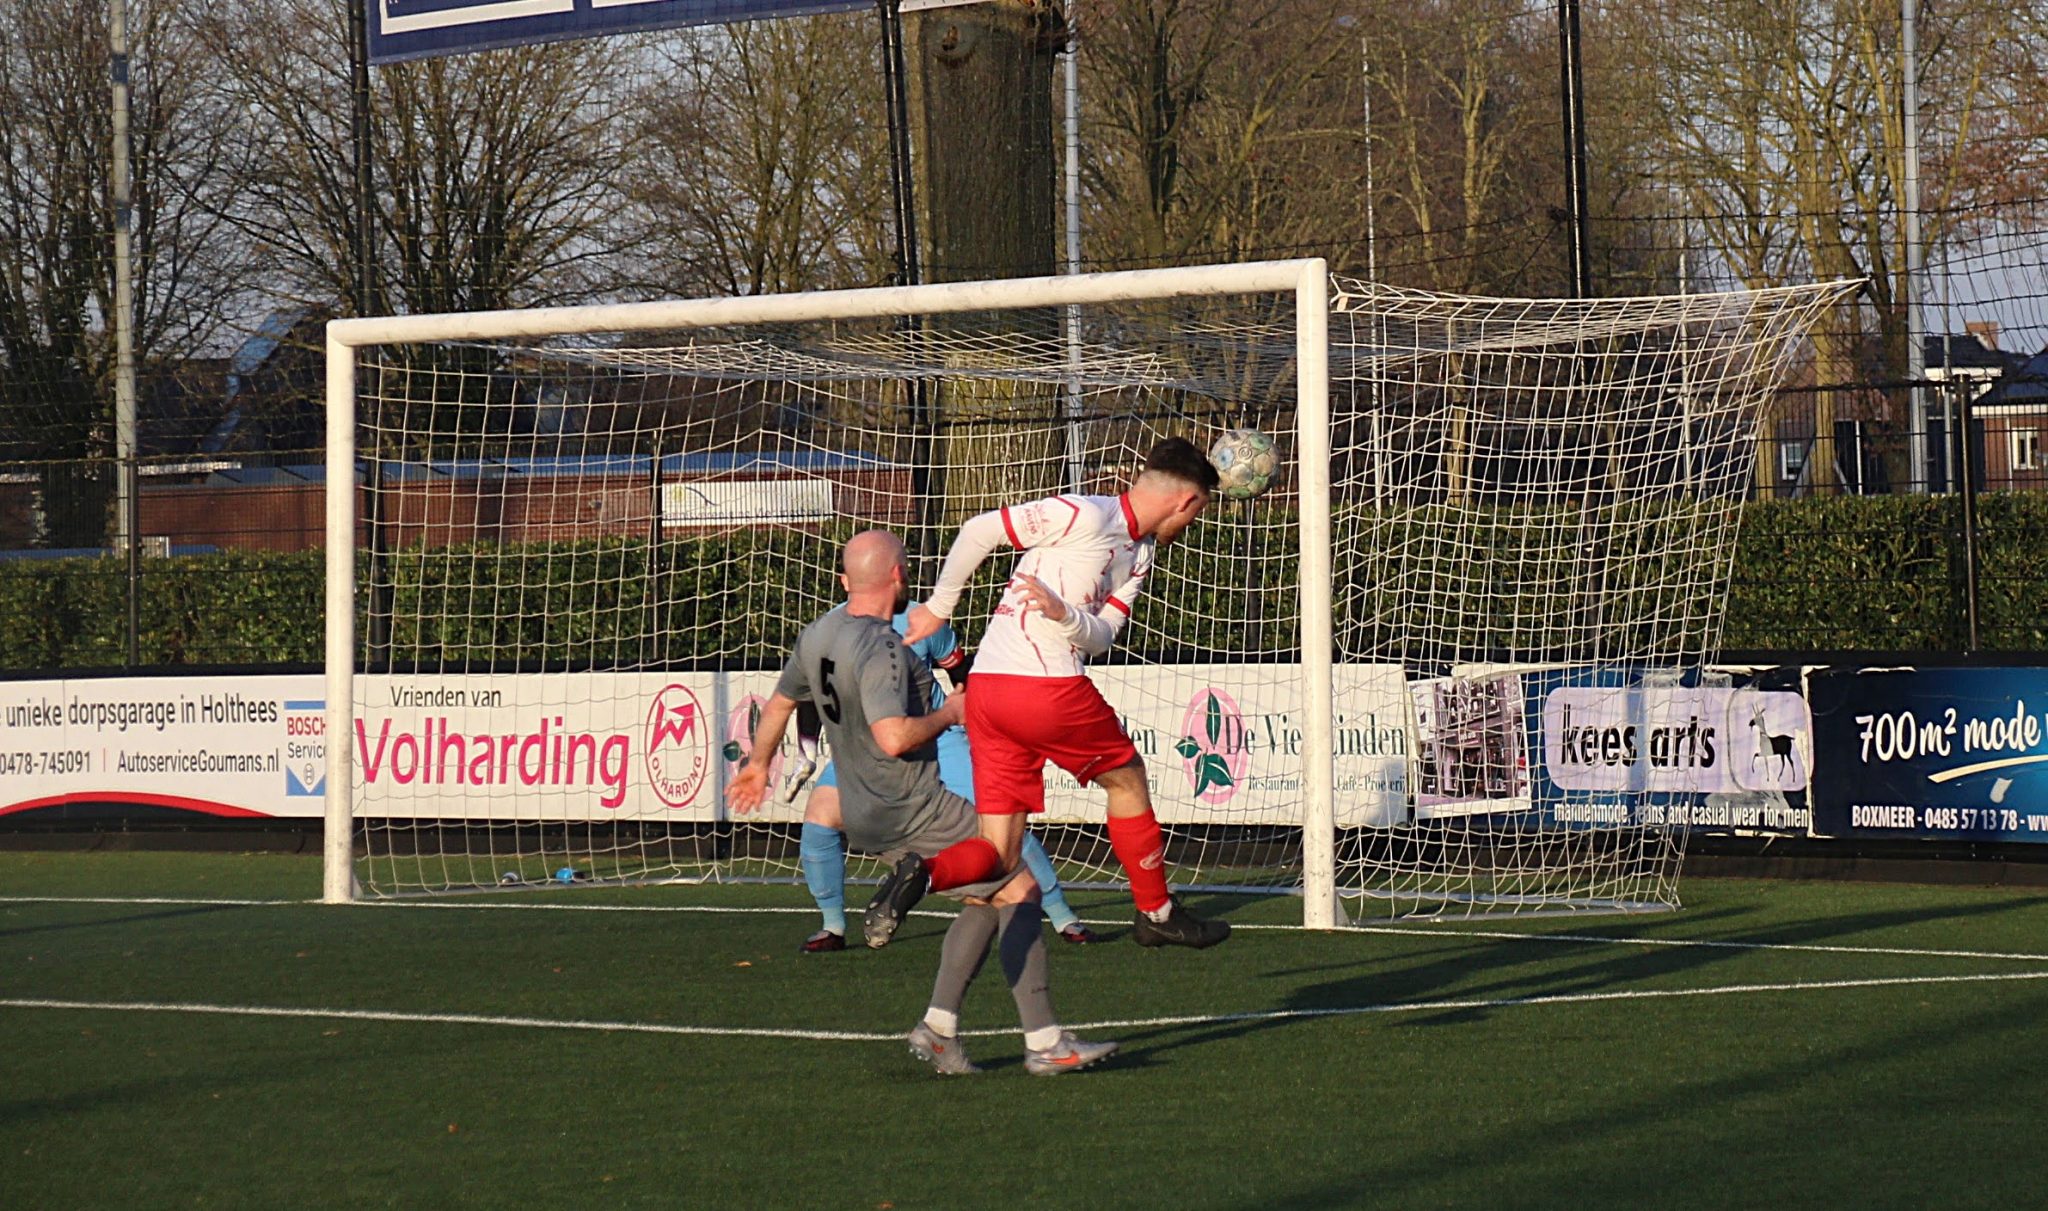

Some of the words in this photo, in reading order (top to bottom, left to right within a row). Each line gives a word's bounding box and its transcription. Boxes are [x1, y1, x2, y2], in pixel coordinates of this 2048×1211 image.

[391, 685, 465, 707] Vrienden
[471, 690, 502, 708] van
[820, 657, 840, 725] 5
[6, 697, 62, 727] unieke
[69, 694, 176, 732] dorpsgarage
[180, 695, 195, 723] in
[201, 694, 277, 723] Holthees
[1964, 699, 2041, 752] mode
[1226, 715, 1255, 756] De
[1264, 714, 1302, 755] Vie
[1333, 713, 1405, 756] inden
[1561, 703, 1638, 767] kees
[1650, 715, 1715, 768] arts
[117, 748, 279, 773] AutoserviceGoumans.nl
[354, 717, 630, 808] Volharding
[1249, 775, 1299, 791] Restaurant
[1364, 775, 1406, 794] Proeerij
[1668, 801, 1689, 824] and
[1692, 801, 1729, 826] casual
[1732, 806, 1761, 826] wear
[1764, 803, 1781, 826] for
[1783, 807, 1808, 828] men
[1852, 805, 1915, 828] BOXMEER
[1925, 807, 1958, 829] 0485
[1961, 808, 1978, 830] 57
[1982, 809, 1997, 830] 13
[2000, 809, 2018, 831] 78
